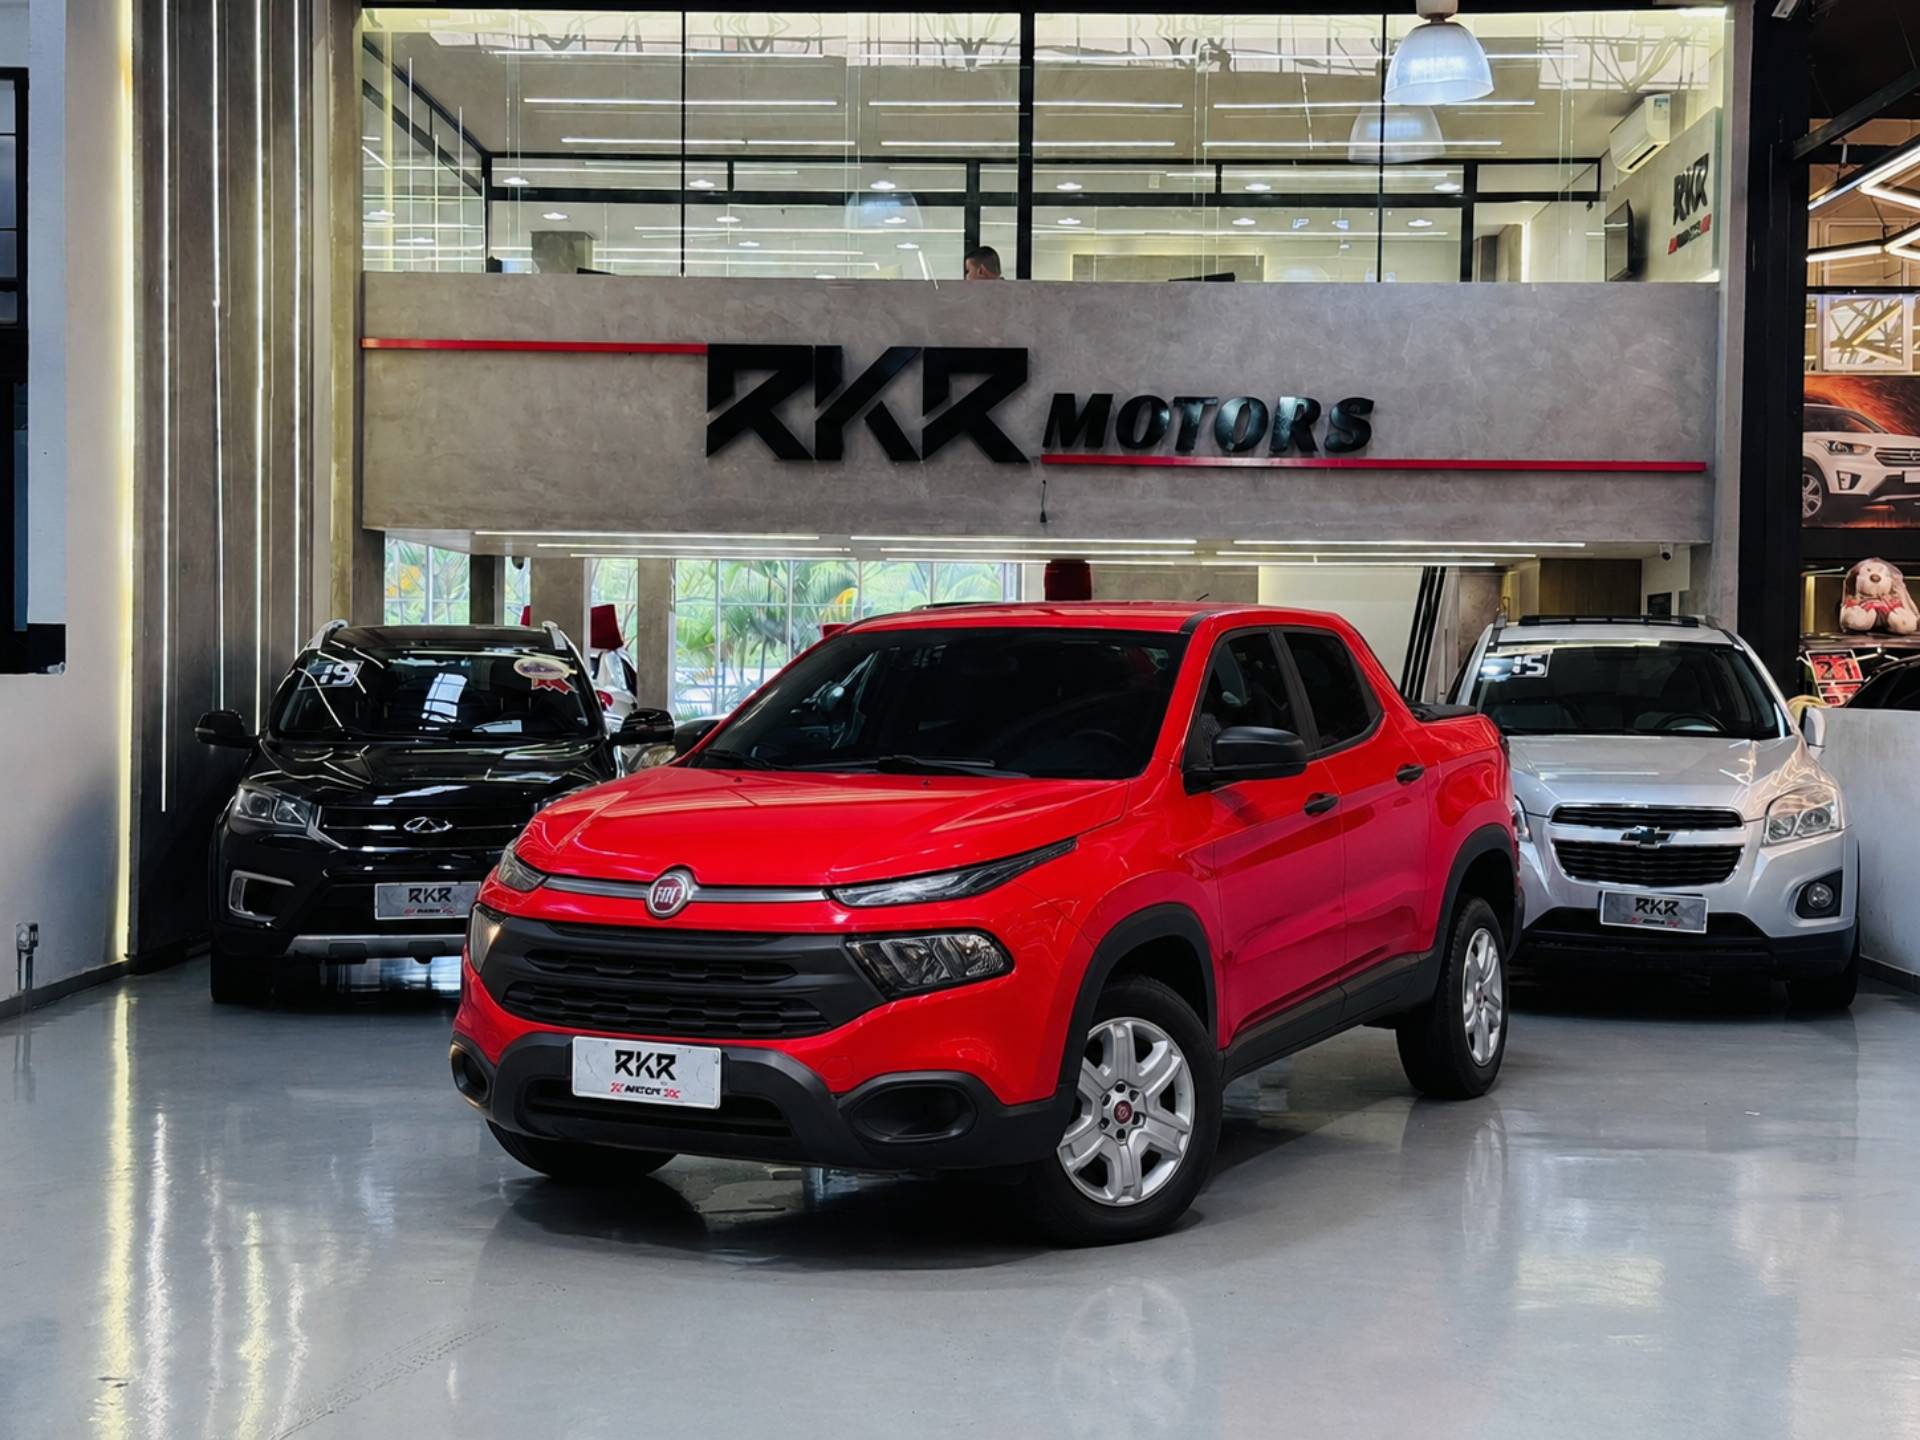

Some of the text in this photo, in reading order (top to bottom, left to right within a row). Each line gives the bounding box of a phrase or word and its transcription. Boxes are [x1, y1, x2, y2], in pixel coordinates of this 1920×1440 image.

[706, 344, 1375, 463] RKR MOTORS
[319, 662, 359, 684] 19
[408, 887, 452, 903] RKR
[1634, 897, 1680, 916] RKR
[615, 1049, 677, 1081] RKR
